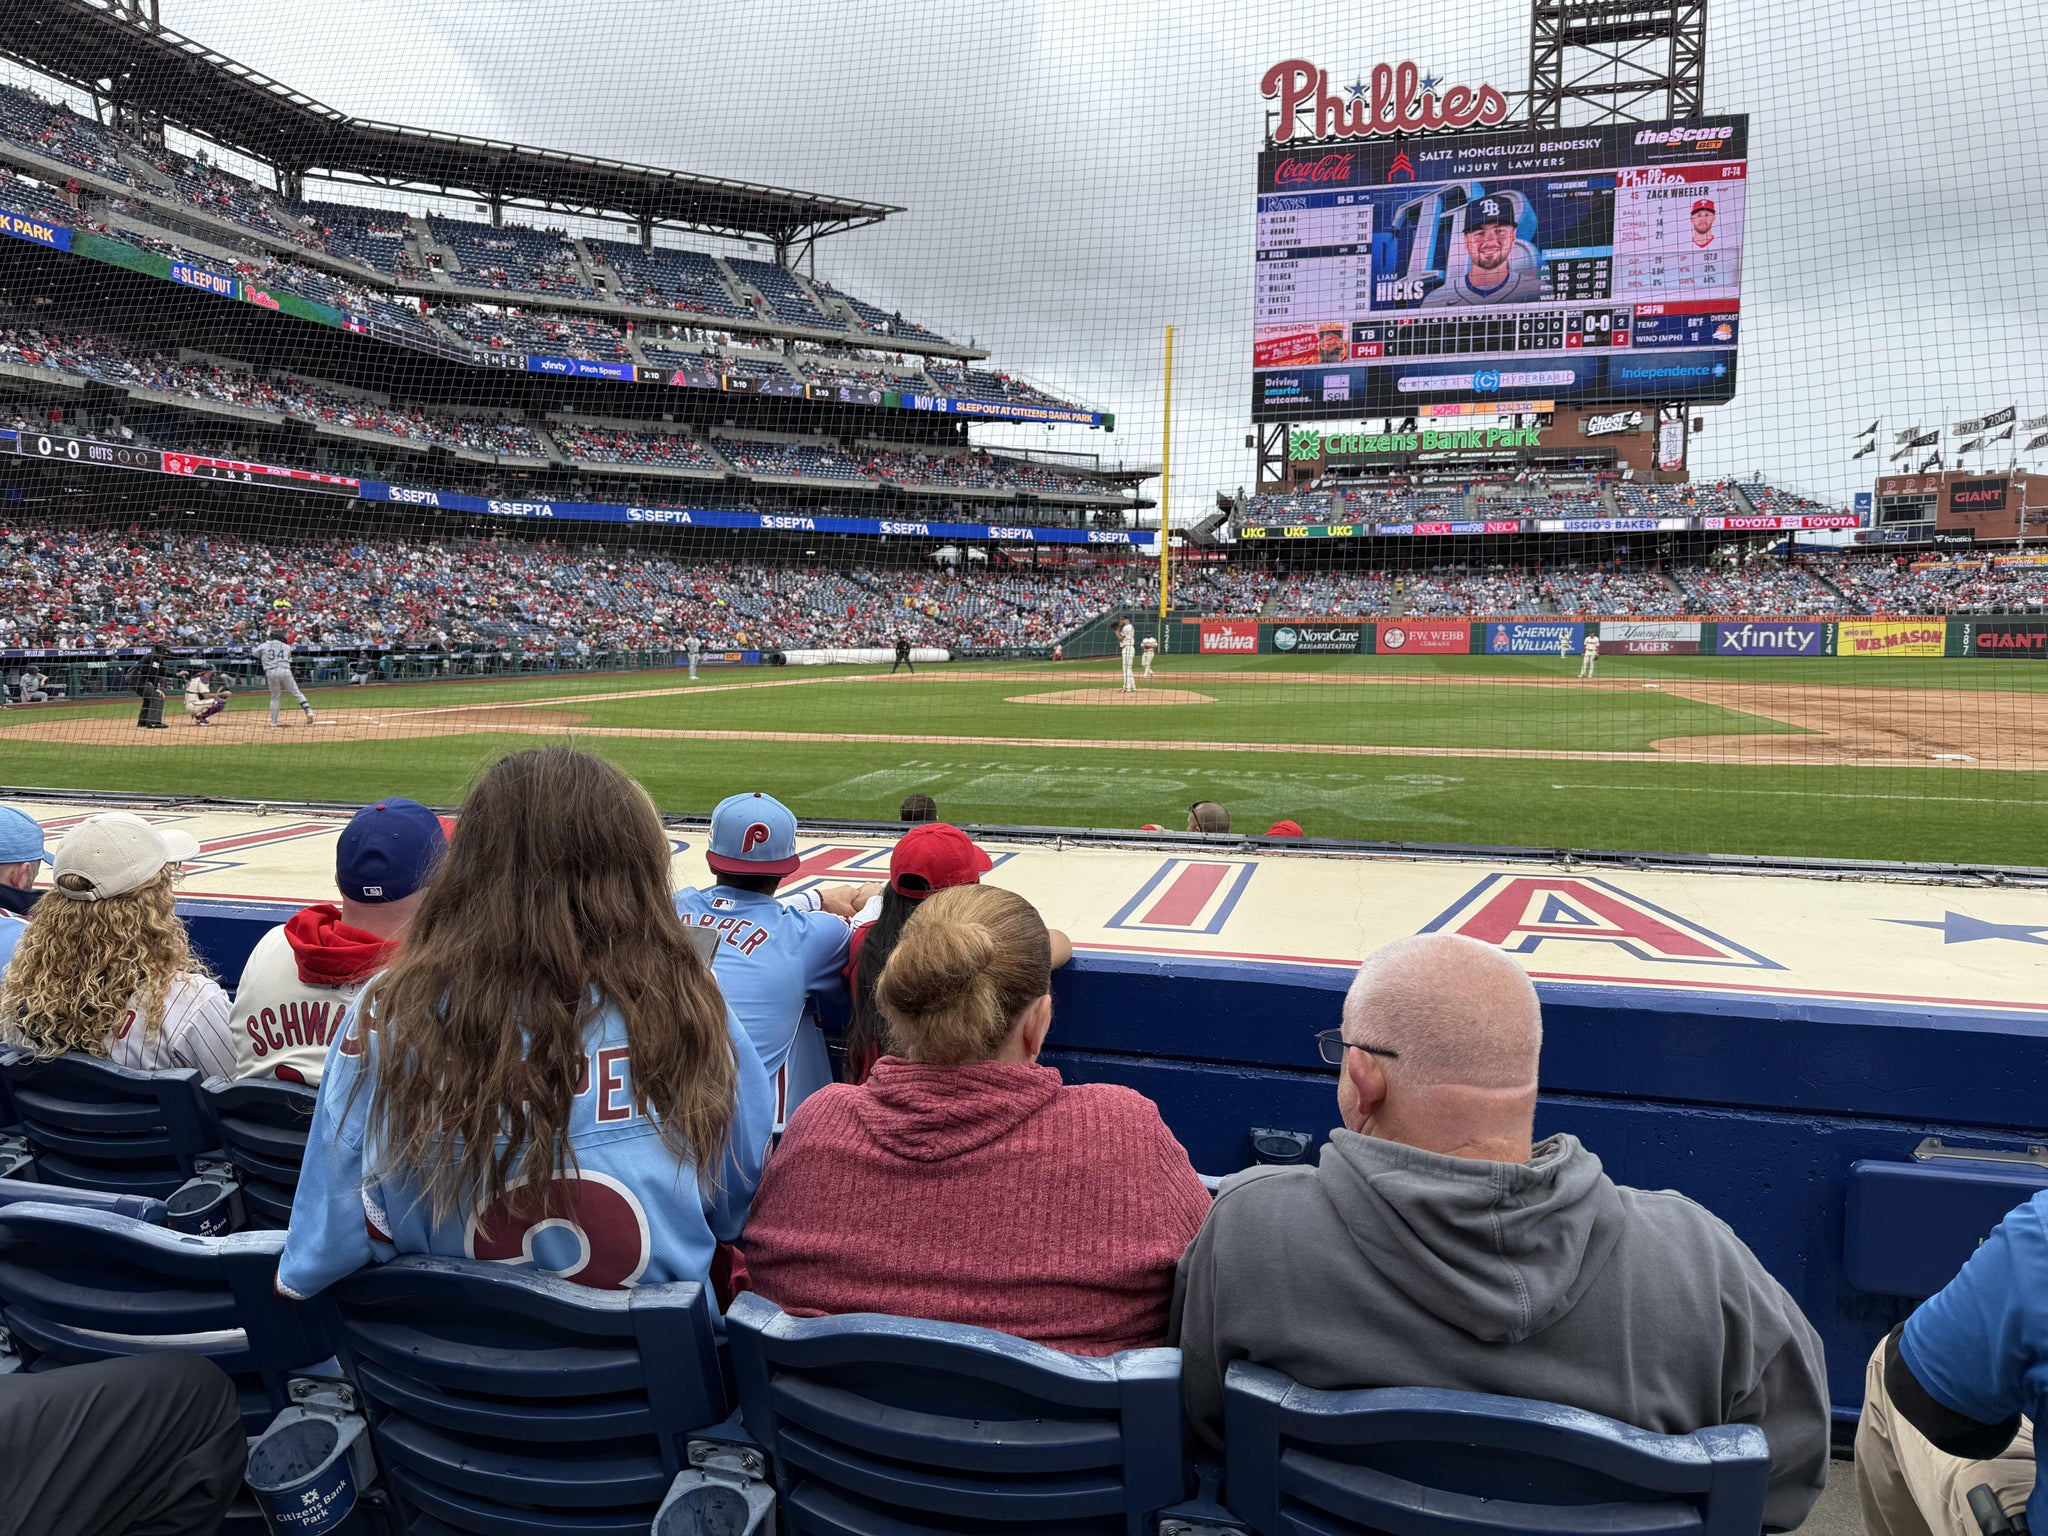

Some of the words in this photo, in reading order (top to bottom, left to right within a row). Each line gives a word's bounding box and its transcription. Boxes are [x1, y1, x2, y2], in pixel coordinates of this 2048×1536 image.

[1261, 60, 1507, 142] Phillies
[1634, 126, 1734, 146] theScore
[1419, 150, 1454, 163] SALTZ
[1458, 145, 1535, 159] MONGELUZZI
[1539, 138, 1602, 152] BENDESKY
[1453, 162, 1498, 174] INJURY
[1508, 157, 1566, 170] LAWYERS
[1721, 166, 1741, 177] 87-74
[1617, 168, 1686, 188] Phillies
[1646, 189, 1669, 200] ZACK
[1670, 186, 1709, 199] WHEELER
[13, 220, 56, 243] PARK
[181, 266, 212, 288] SLEEP
[212, 274, 232, 296] OUT
[1376, 273, 1398, 281] LIAM
[244, 284, 280, 310] Phillies
[1376, 281, 1424, 302] HICKS
[1637, 320, 1660, 329] TEMP
[1710, 313, 1739, 322] OVERCAST
[1360, 329, 1376, 341] TB
[1570, 320, 1578, 329] 4
[1585, 315, 1610, 332] 0-0
[1618, 318, 1625, 327] 2
[1357, 345, 1377, 357] PHI
[1569, 336, 1578, 345] 4
[1617, 333, 1625, 342] 2
[1636, 334, 1658, 343] WIND
[1658, 333, 1683, 342] (MPH)
[541, 360, 568, 373] xfinity
[580, 364, 598, 374] Pitch
[1621, 364, 1710, 380] Independence
[643, 371, 660, 381] 3:10
[1265, 377, 1299, 387] Driving
[1399, 378, 1472, 388] NEX-GEN
[1501, 372, 1574, 385] HYPERBARIC
[732, 379, 747, 390] 3:10
[1264, 387, 1301, 396] smarter
[914, 395, 934, 411] NOV
[935, 398, 948, 412] 19
[1264, 396, 1312, 405] outcomes.
[956, 401, 982, 413] SLEEP
[982, 404, 1001, 415] OUT
[1000, 406, 1012, 416] AT
[1011, 406, 1048, 419] CITIZENS
[1048, 410, 1072, 421] BANK
[1071, 412, 1094, 423] PARK
[1988, 409, 2012, 426] 2009
[1587, 411, 1633, 437] GHOST
[1325, 433, 1418, 454] Citizens
[1422, 429, 1483, 450] Bank
[1486, 425, 1541, 448] Park
[38, 436, 80, 459] 0-0
[89, 446, 113, 462] OUTS
[227, 470, 236, 480] 14
[243, 472, 252, 482] 21
[403, 489, 439, 506] SEPTA
[1954, 489, 2002, 503] GIANT
[501, 502, 553, 517] SEPTA
[644, 509, 692, 524] SEPTA
[776, 517, 815, 529] SEPTA
[1415, 523, 1450, 534] NECA
[1487, 521, 1519, 533] NECA
[1563, 519, 1612, 530] LISCIO'S
[1615, 519, 1661, 530] BAKERY
[1726, 517, 1777, 528] TOYOTA
[1804, 516, 1856, 527] TOYOTA
[893, 522, 929, 536] SEPTA
[1001, 528, 1034, 540] SEPTA
[1241, 527, 1266, 538] UKG
[1284, 526, 1309, 538] UKG
[1327, 525, 1353, 537] UKG
[1099, 531, 1130, 543] SEPTA
[1944, 536, 1972, 544] Fanatics
[1298, 628, 1359, 642] NovaCare
[1409, 631, 1429, 641] F.W.
[1431, 631, 1464, 641] WEBB
[1512, 625, 1574, 638] SHERWIN
[1618, 624, 1683, 640] Yuengling
[1723, 623, 1815, 652] xfinity
[1203, 632, 1255, 650] Wawa
[1298, 642, 1357, 650] REHABILITATION
[1825, 623, 1834, 655] 374
[1963, 623, 1971, 656] 387
[1976, 633, 2048, 648] GIANT
[1628, 642, 1670, 652] LAGER
[268, 649, 285, 661] 34
[276, 1503, 323, 1523] Citizens
[322, 1479, 348, 1505] Bank
[302, 1507, 330, 1527] Park
